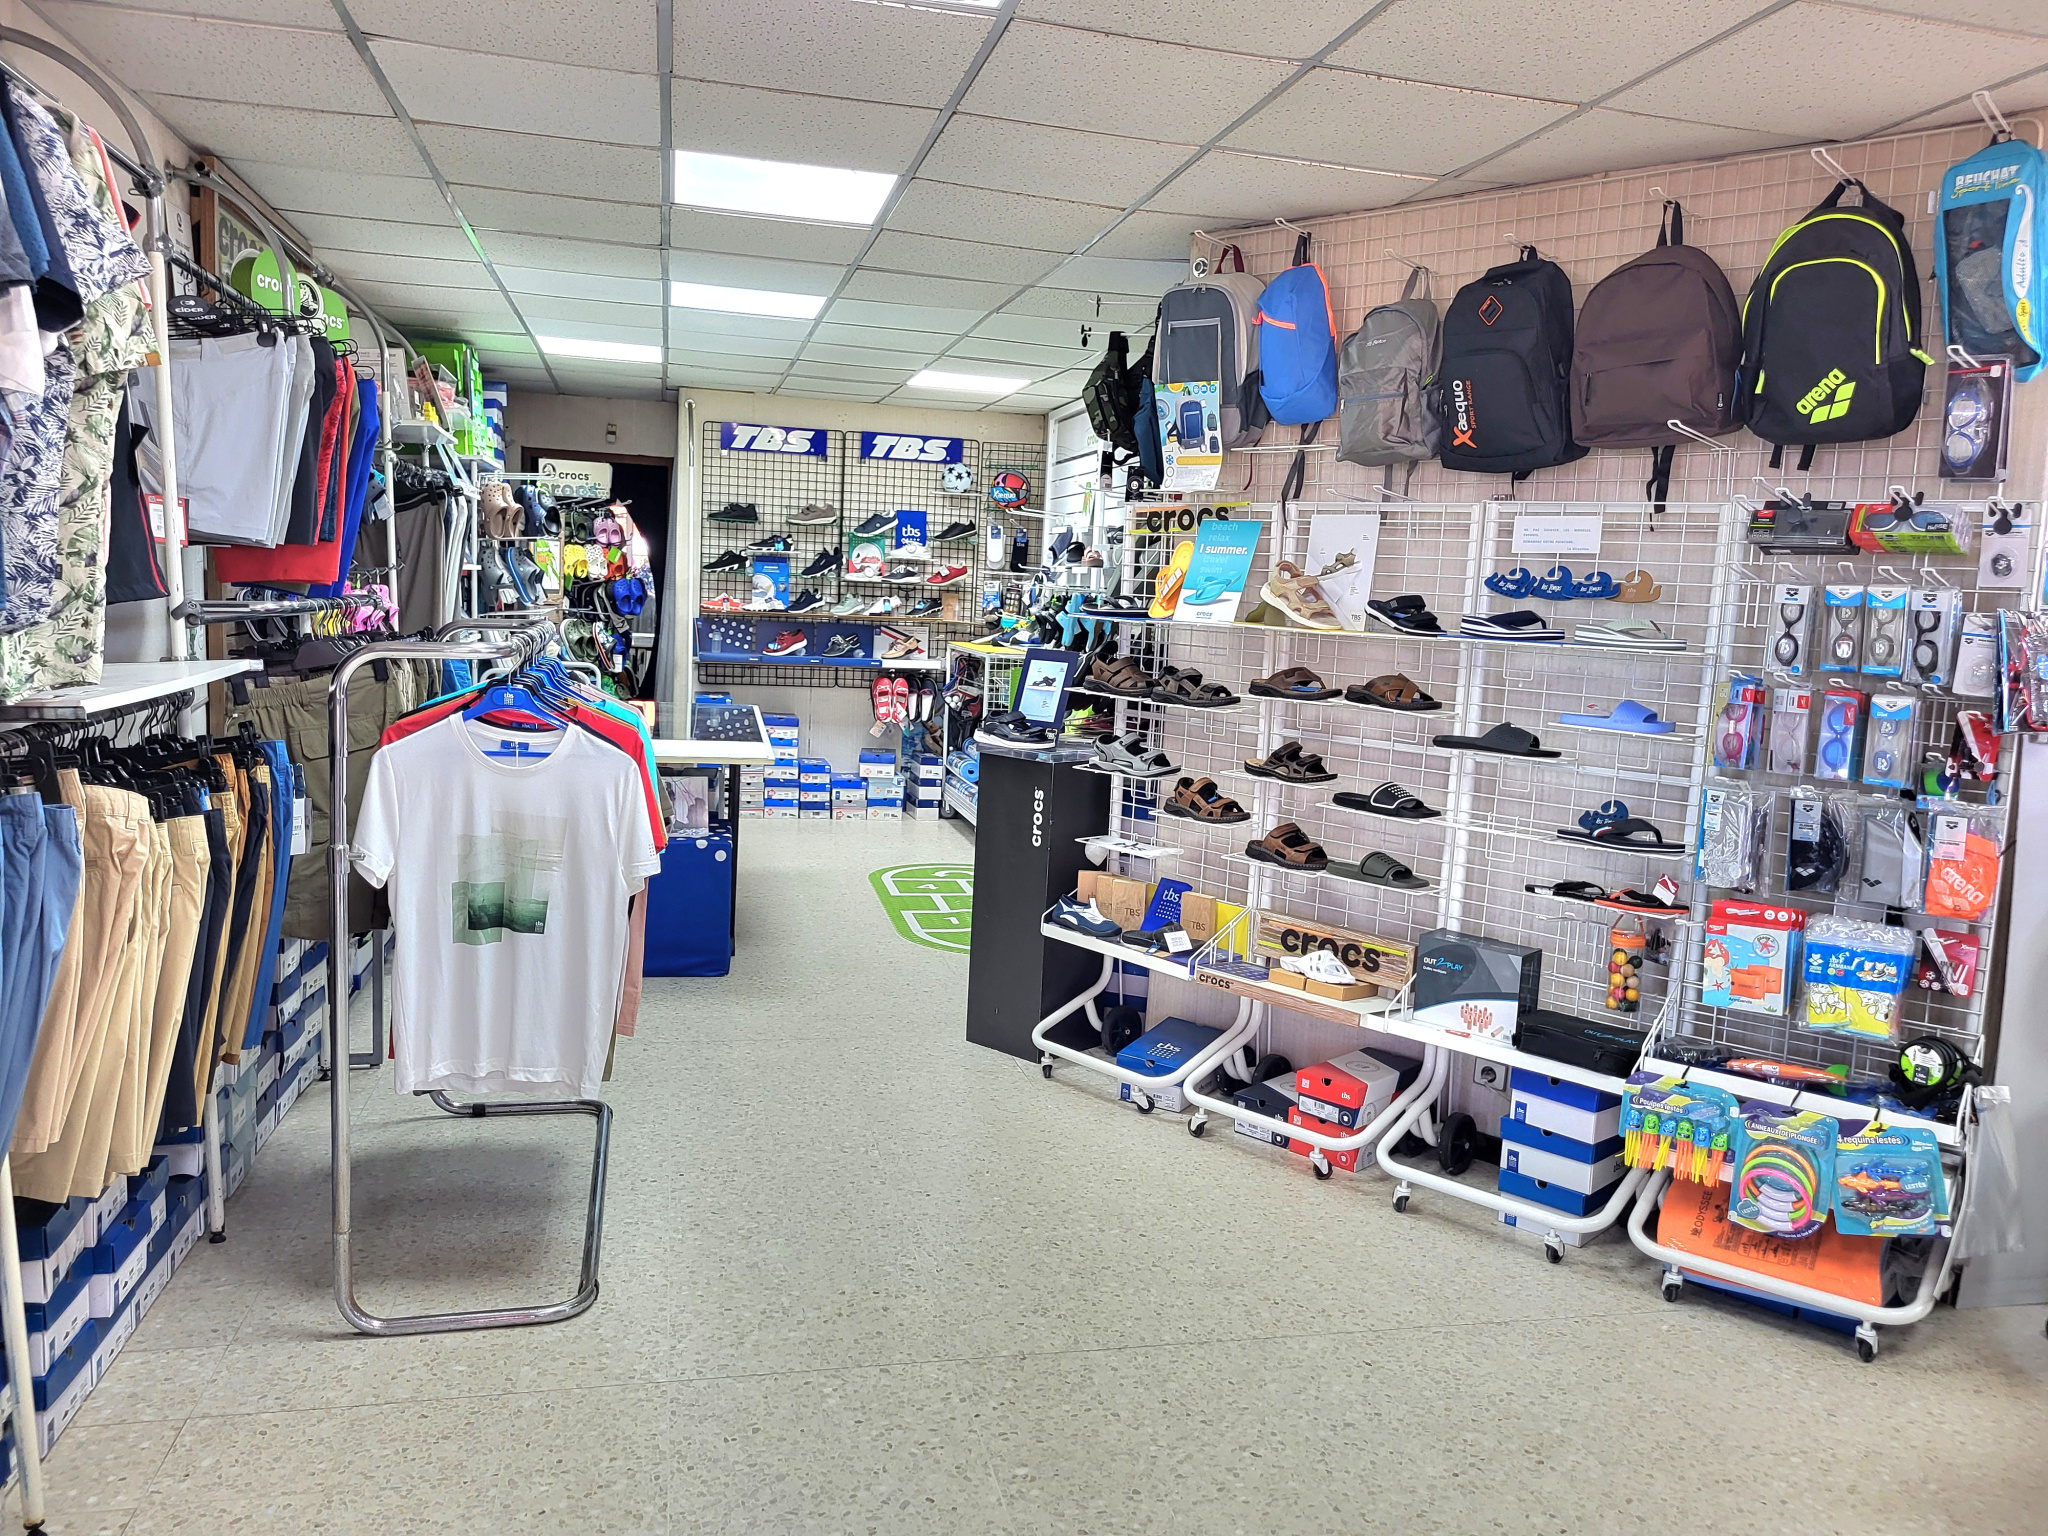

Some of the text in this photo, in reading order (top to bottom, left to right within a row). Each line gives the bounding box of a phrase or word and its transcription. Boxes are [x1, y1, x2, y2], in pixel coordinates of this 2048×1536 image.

[1795, 367, 1848, 416] arena
[1468, 407, 1477, 429] SPORT
[730, 425, 815, 454] TBS
[869, 434, 952, 462] TBS
[558, 472, 589, 481] crocs
[902, 523, 921, 537] tbs
[1212, 522, 1239, 531] beach
[1208, 533, 1231, 542] relax
[1200, 543, 1248, 555] I summer.
[1203, 555, 1229, 563] travel
[1199, 565, 1223, 574] swim
[1031, 789, 1044, 848] crocs
[1940, 866, 1985, 905] arena
[1162, 888, 1180, 903] tbs
[1124, 907, 1140, 917] TBS
[1191, 921, 1206, 931] TBS
[1280, 928, 1381, 973] crocs
[1199, 973, 1231, 990] crocs
[1341, 1091, 1351, 1100] tbs
[1639, 1098, 1664, 1109] Poulpes
[1751, 1122, 1779, 1136] ANNEAUX
[1789, 1130, 1818, 1145] PLONGÉE
[1836, 1134, 1901, 1146] 4 requins lestés
[1905, 1182, 1926, 1190] LESTÉS
